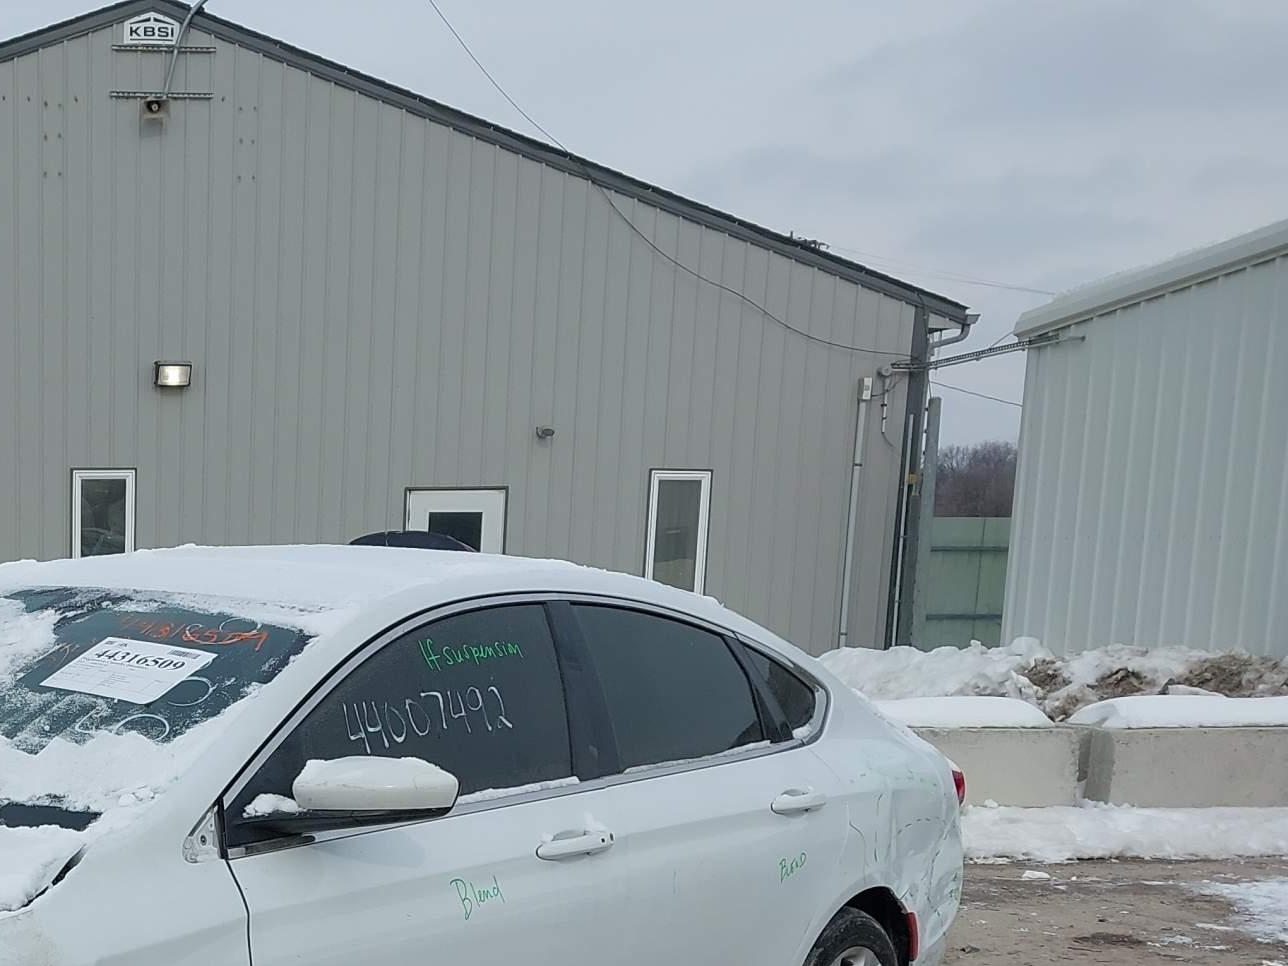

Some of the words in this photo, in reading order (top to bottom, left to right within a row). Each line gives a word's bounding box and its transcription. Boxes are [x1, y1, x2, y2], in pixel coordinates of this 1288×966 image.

[129, 26, 175, 38] KBSI
[95, 650, 186, 671] 44316509
[342, 686, 513, 754] 44007492
[449, 875, 506, 921] Blend
